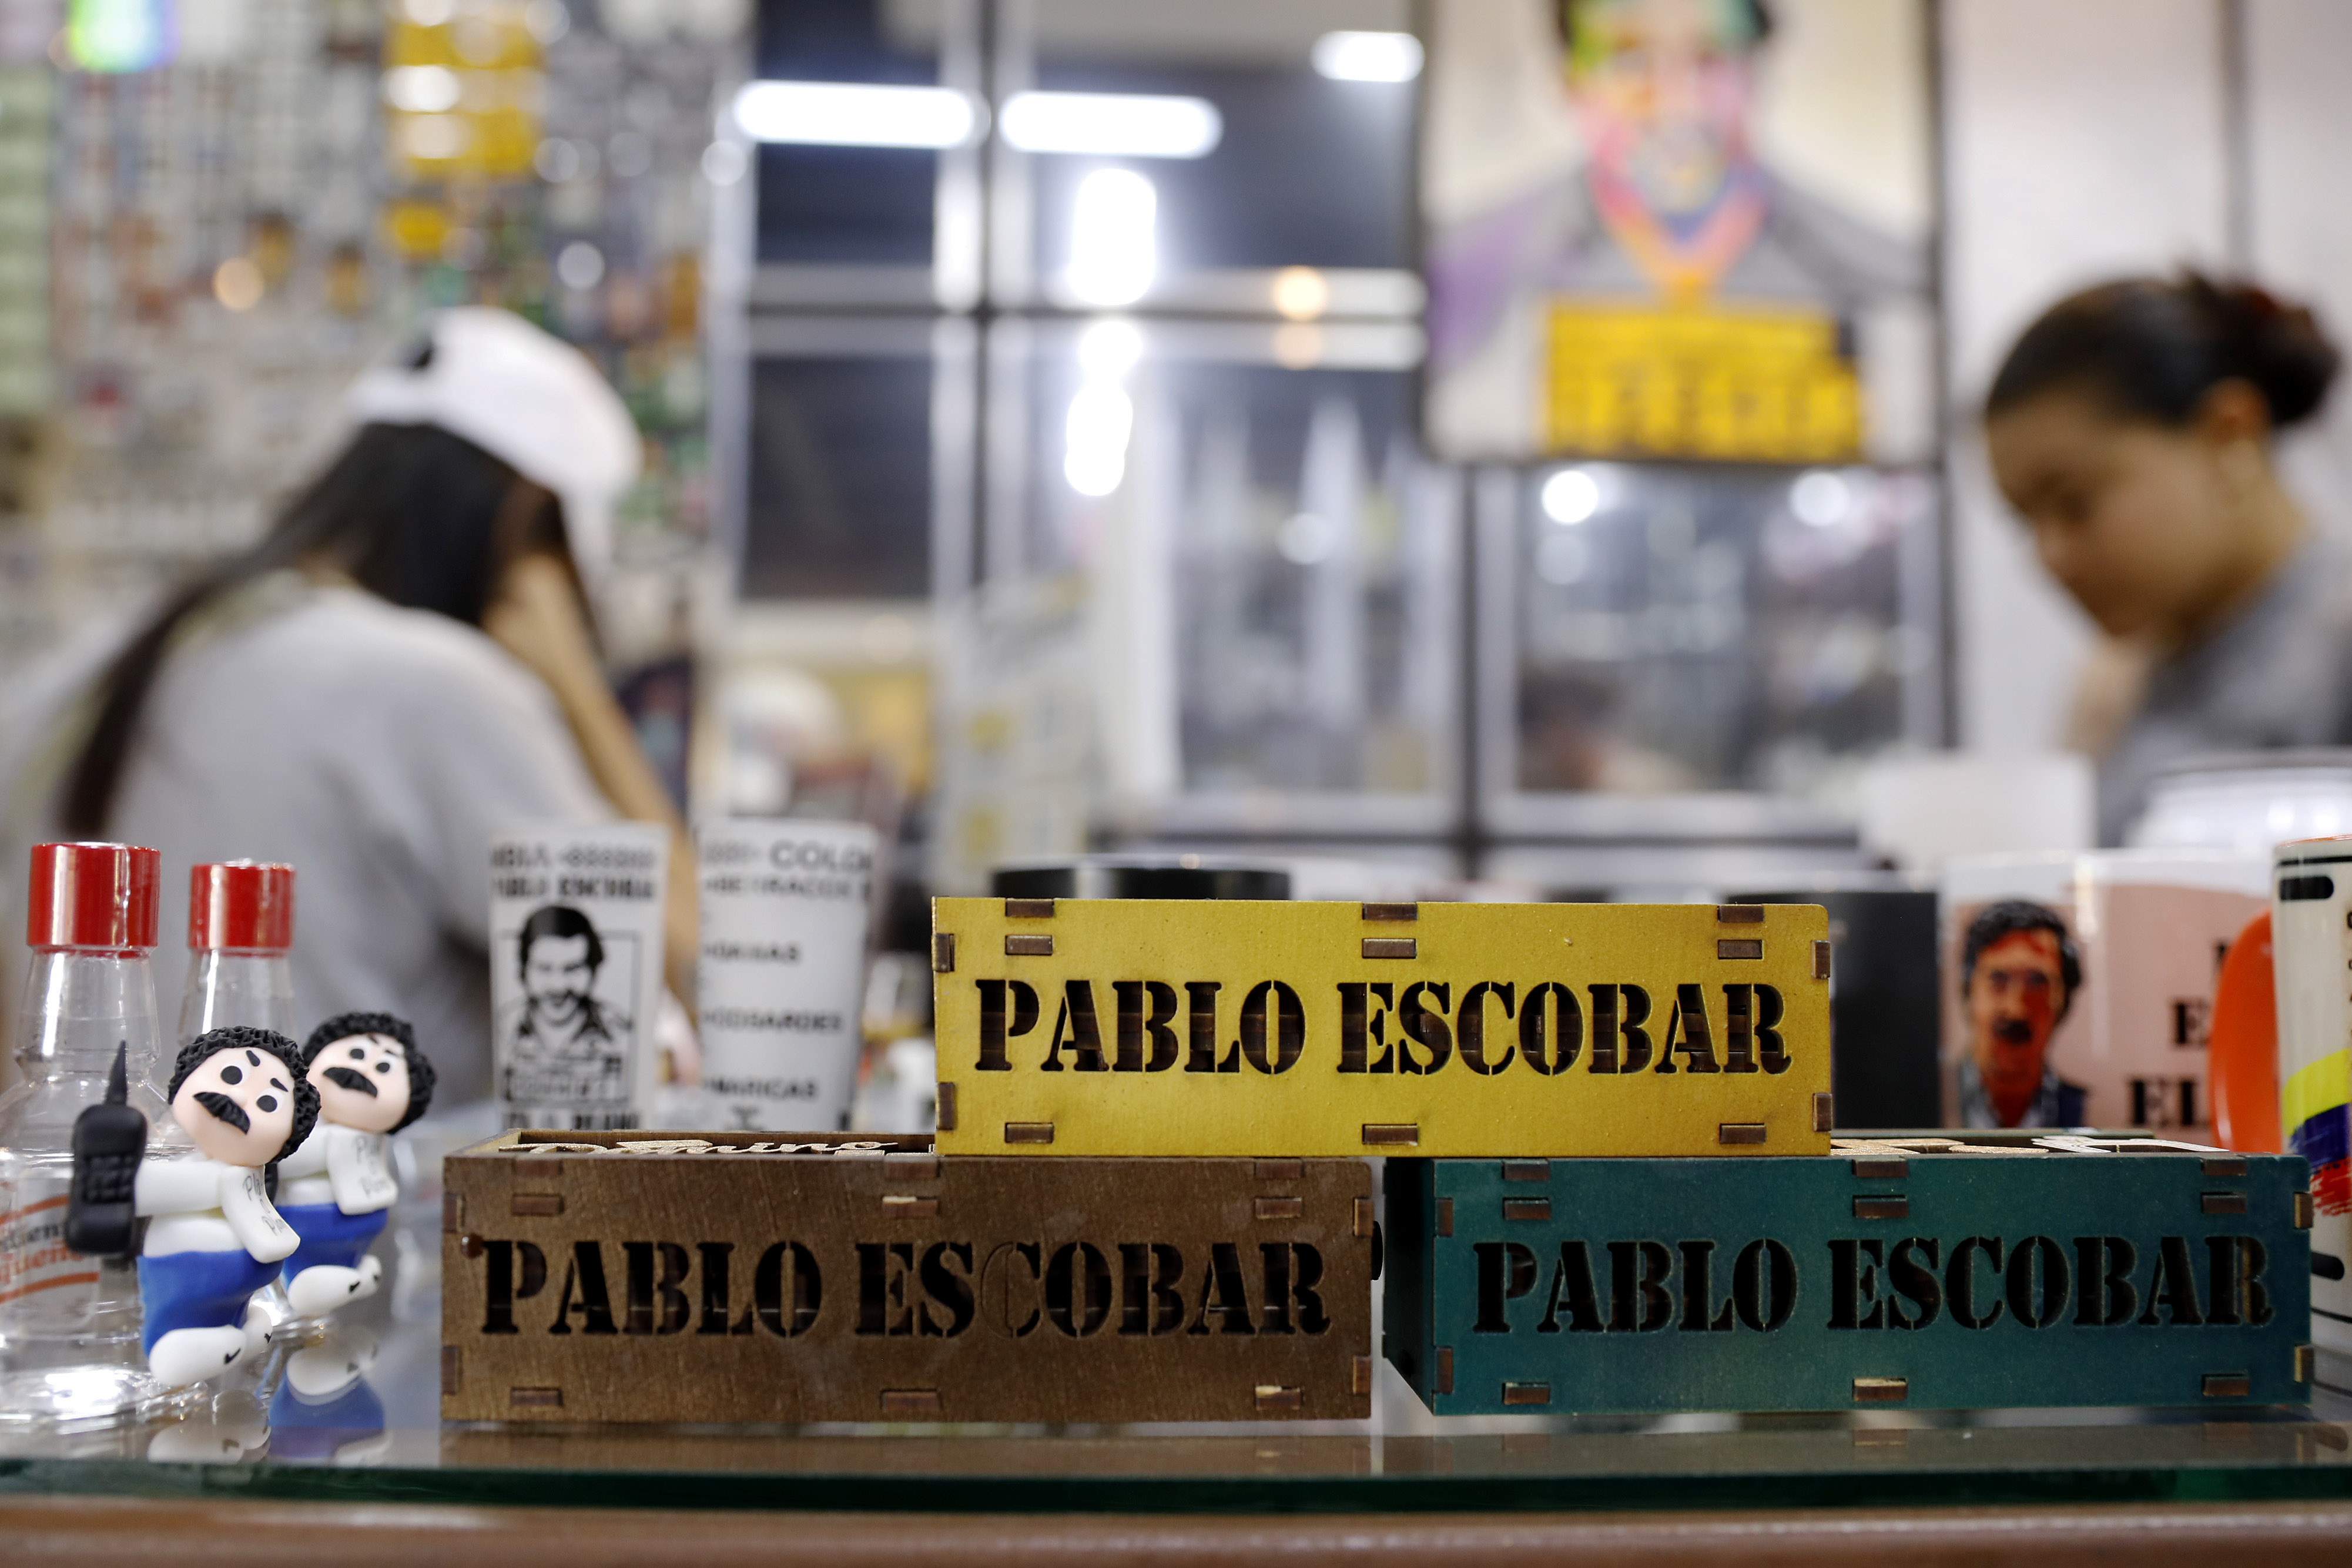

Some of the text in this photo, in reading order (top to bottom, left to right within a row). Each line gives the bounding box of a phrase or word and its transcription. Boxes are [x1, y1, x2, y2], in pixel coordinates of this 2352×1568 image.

[974, 978, 1793, 1077] PABLO ESCOBAR
[481, 1238, 1332, 1339] PABLO ESCOBAR
[1472, 1234, 2276, 1334] PABLO ESCOBAR
